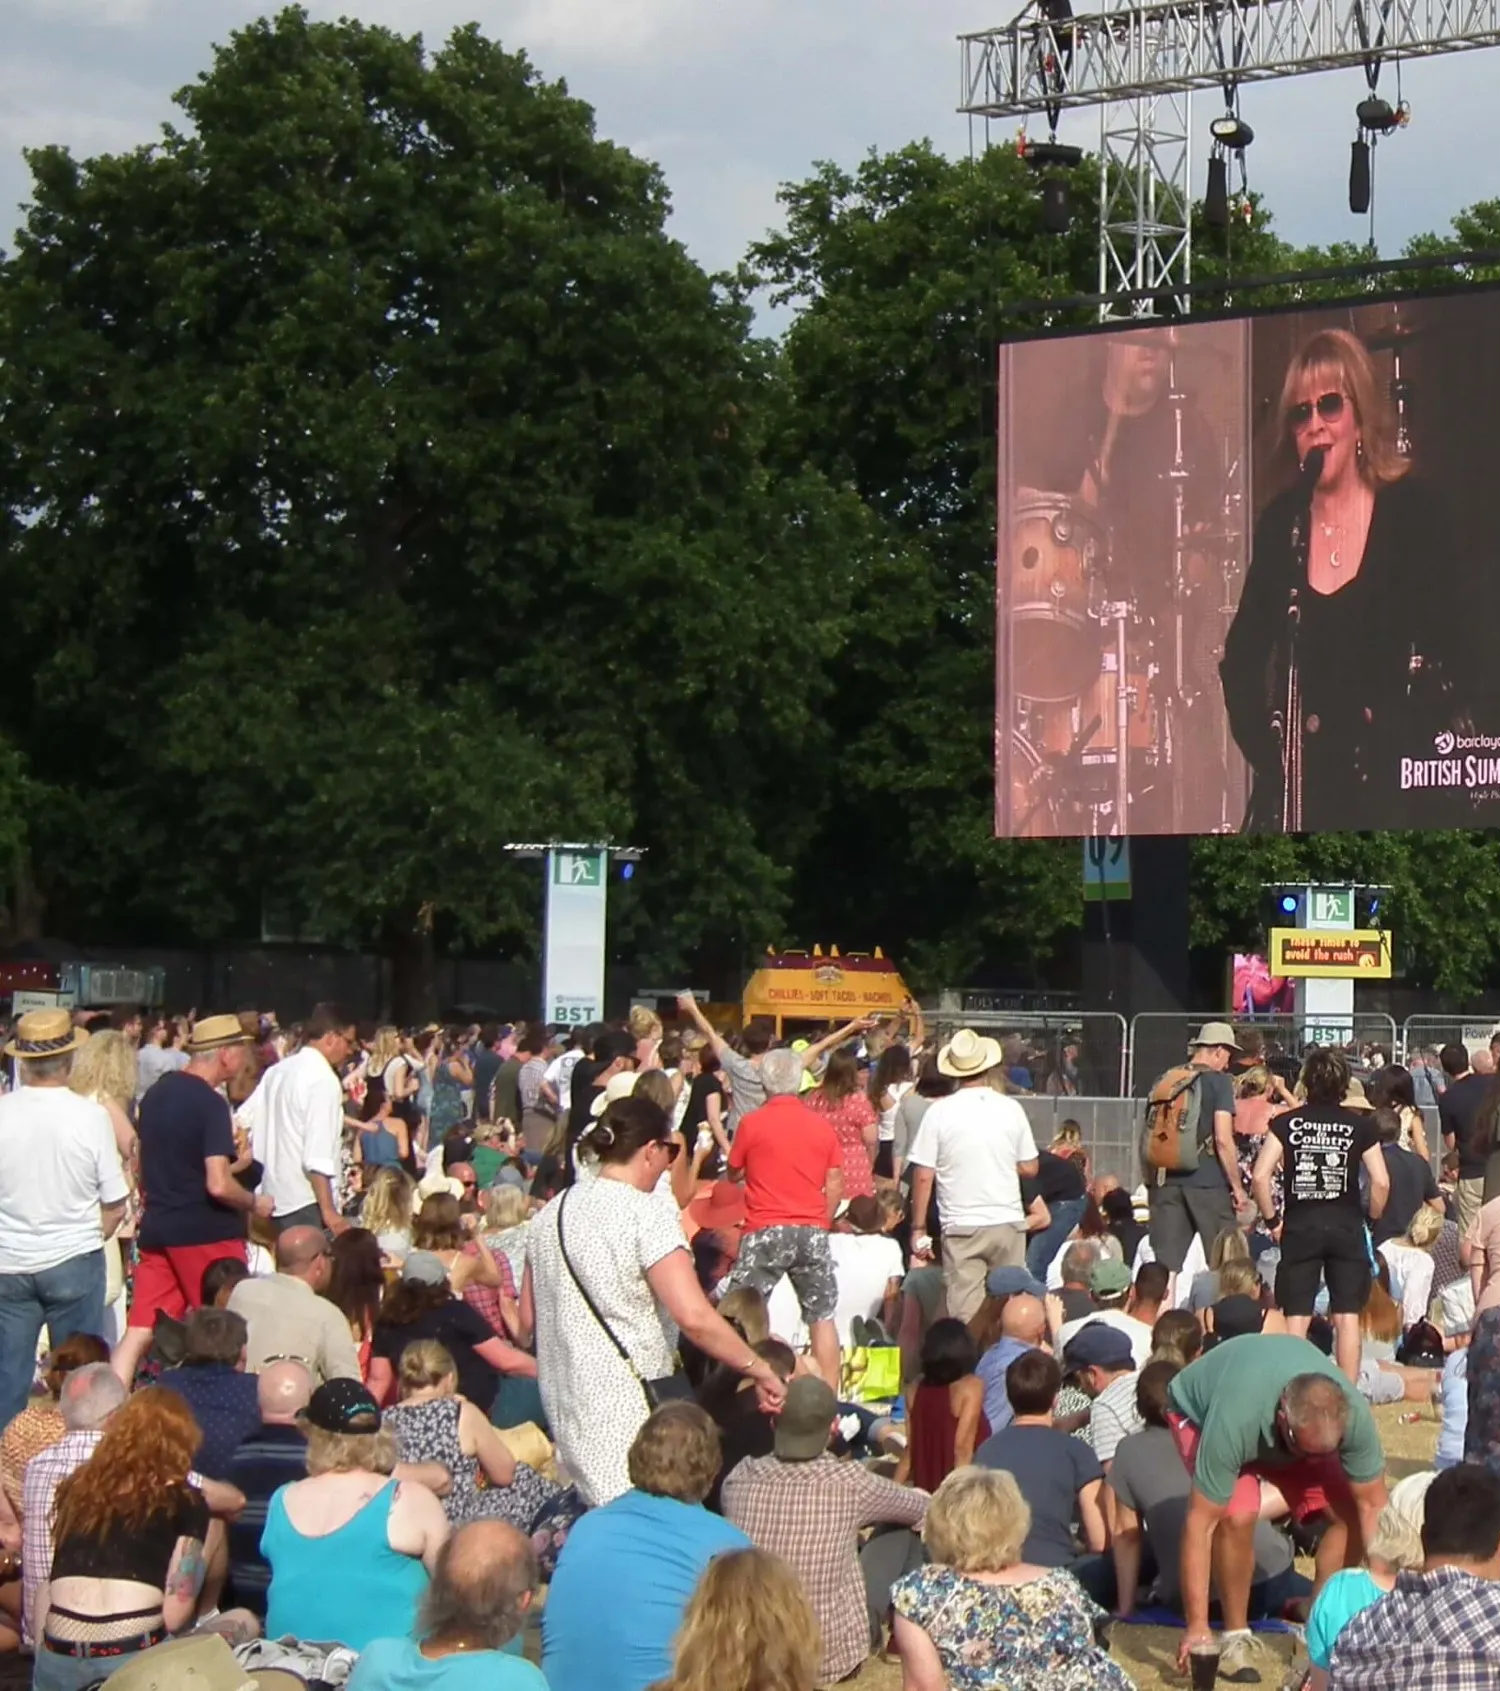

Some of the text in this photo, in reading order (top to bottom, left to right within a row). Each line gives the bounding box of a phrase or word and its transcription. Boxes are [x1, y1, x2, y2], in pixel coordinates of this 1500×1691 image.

[1400, 757, 1462, 789] BRITISH
[1285, 948, 1354, 961] avoid the rush
[555, 1006, 596, 1021] BST
[1313, 1028, 1346, 1041] BST
[1289, 1117, 1354, 1136] Country
[1289, 1131, 1353, 1150] Country
